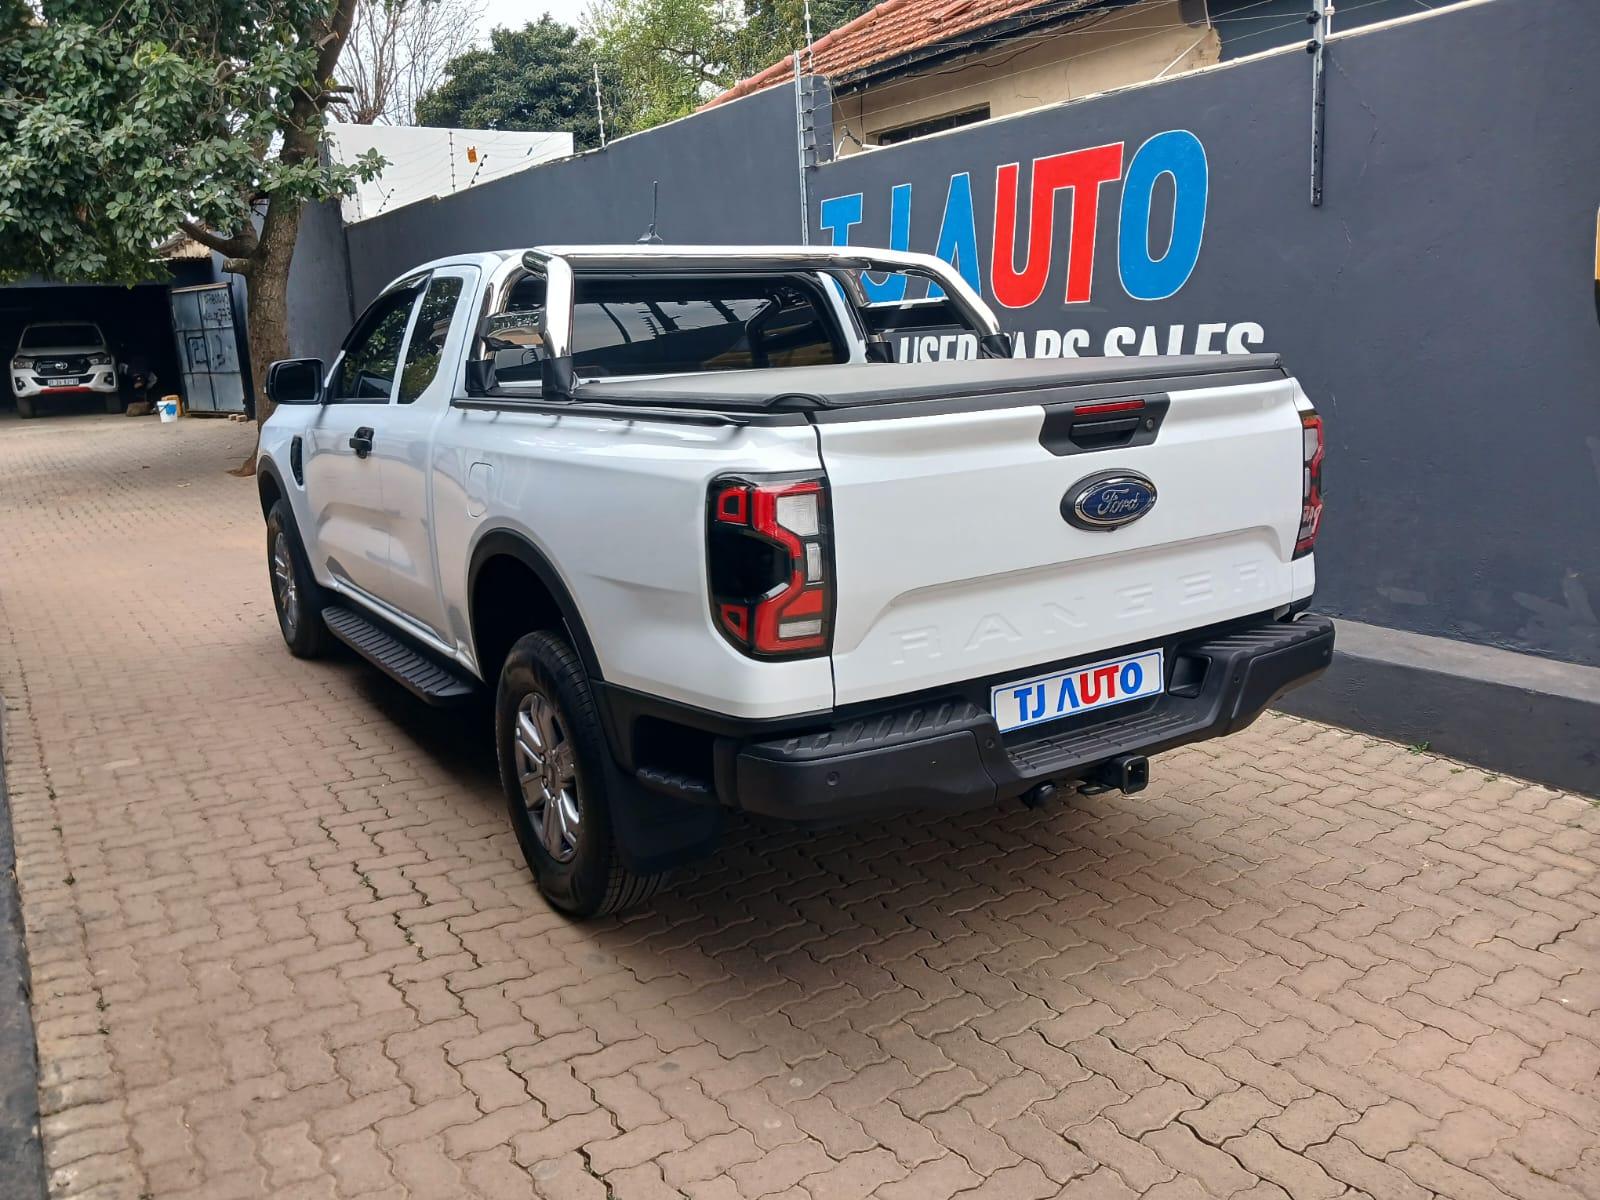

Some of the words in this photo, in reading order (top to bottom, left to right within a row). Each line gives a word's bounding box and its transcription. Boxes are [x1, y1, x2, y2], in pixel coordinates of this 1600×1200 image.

[820, 183, 912, 303] TJ
[926, 129, 1208, 308] AUTO
[1003, 329, 1090, 358] ARS
[1104, 322, 1265, 357] SALES
[1097, 488, 1139, 515] Ford
[890, 559, 1267, 664] RANGER
[1013, 684, 1045, 722] TJ
[1057, 662, 1143, 712] AUTO
